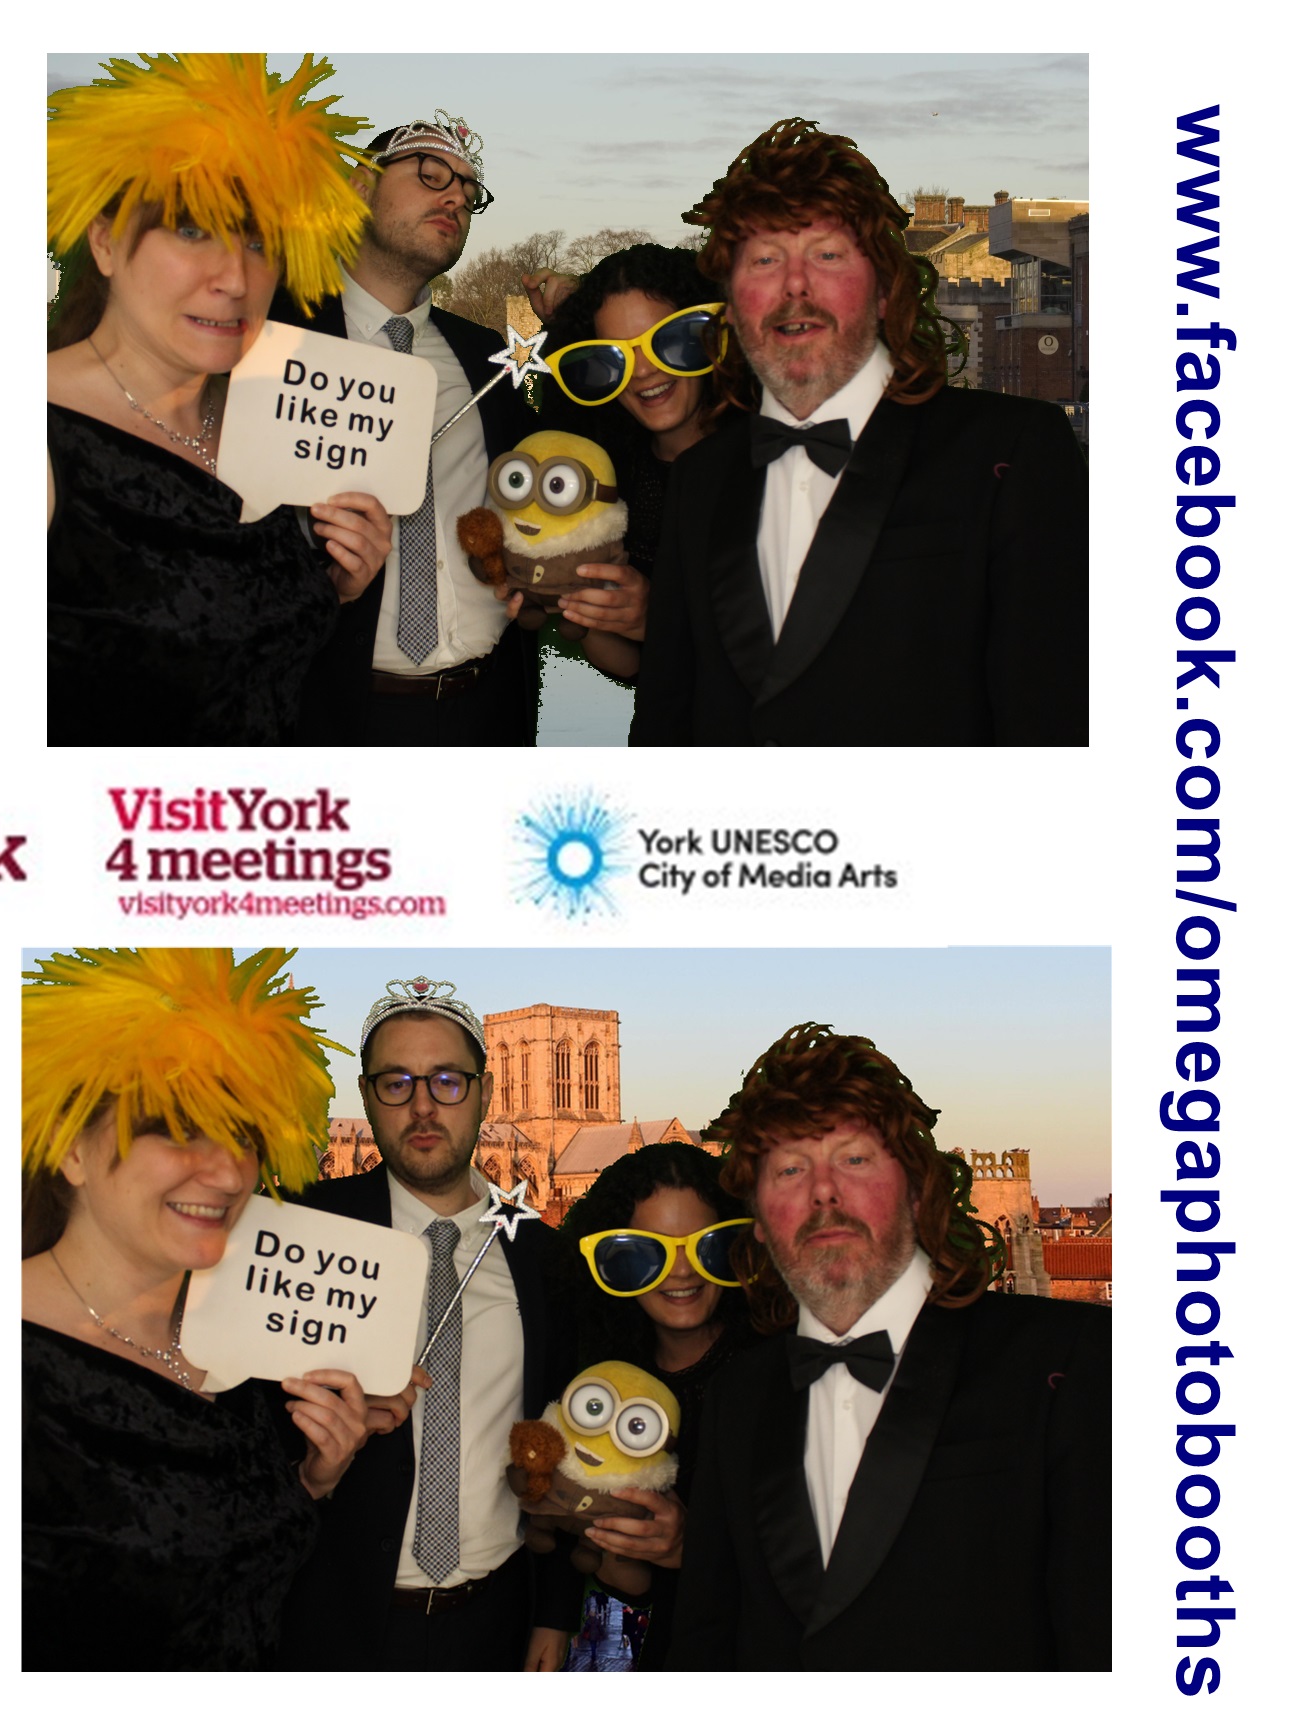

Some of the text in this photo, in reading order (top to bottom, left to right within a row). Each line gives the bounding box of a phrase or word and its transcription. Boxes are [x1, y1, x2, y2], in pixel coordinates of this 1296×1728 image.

[283, 358, 396, 405] Do you
[275, 393, 394, 442] like my
[294, 435, 367, 470] sign
[254, 1230, 380, 1281] Do you
[245, 1264, 378, 1320] like my
[265, 1309, 347, 1346] sign
